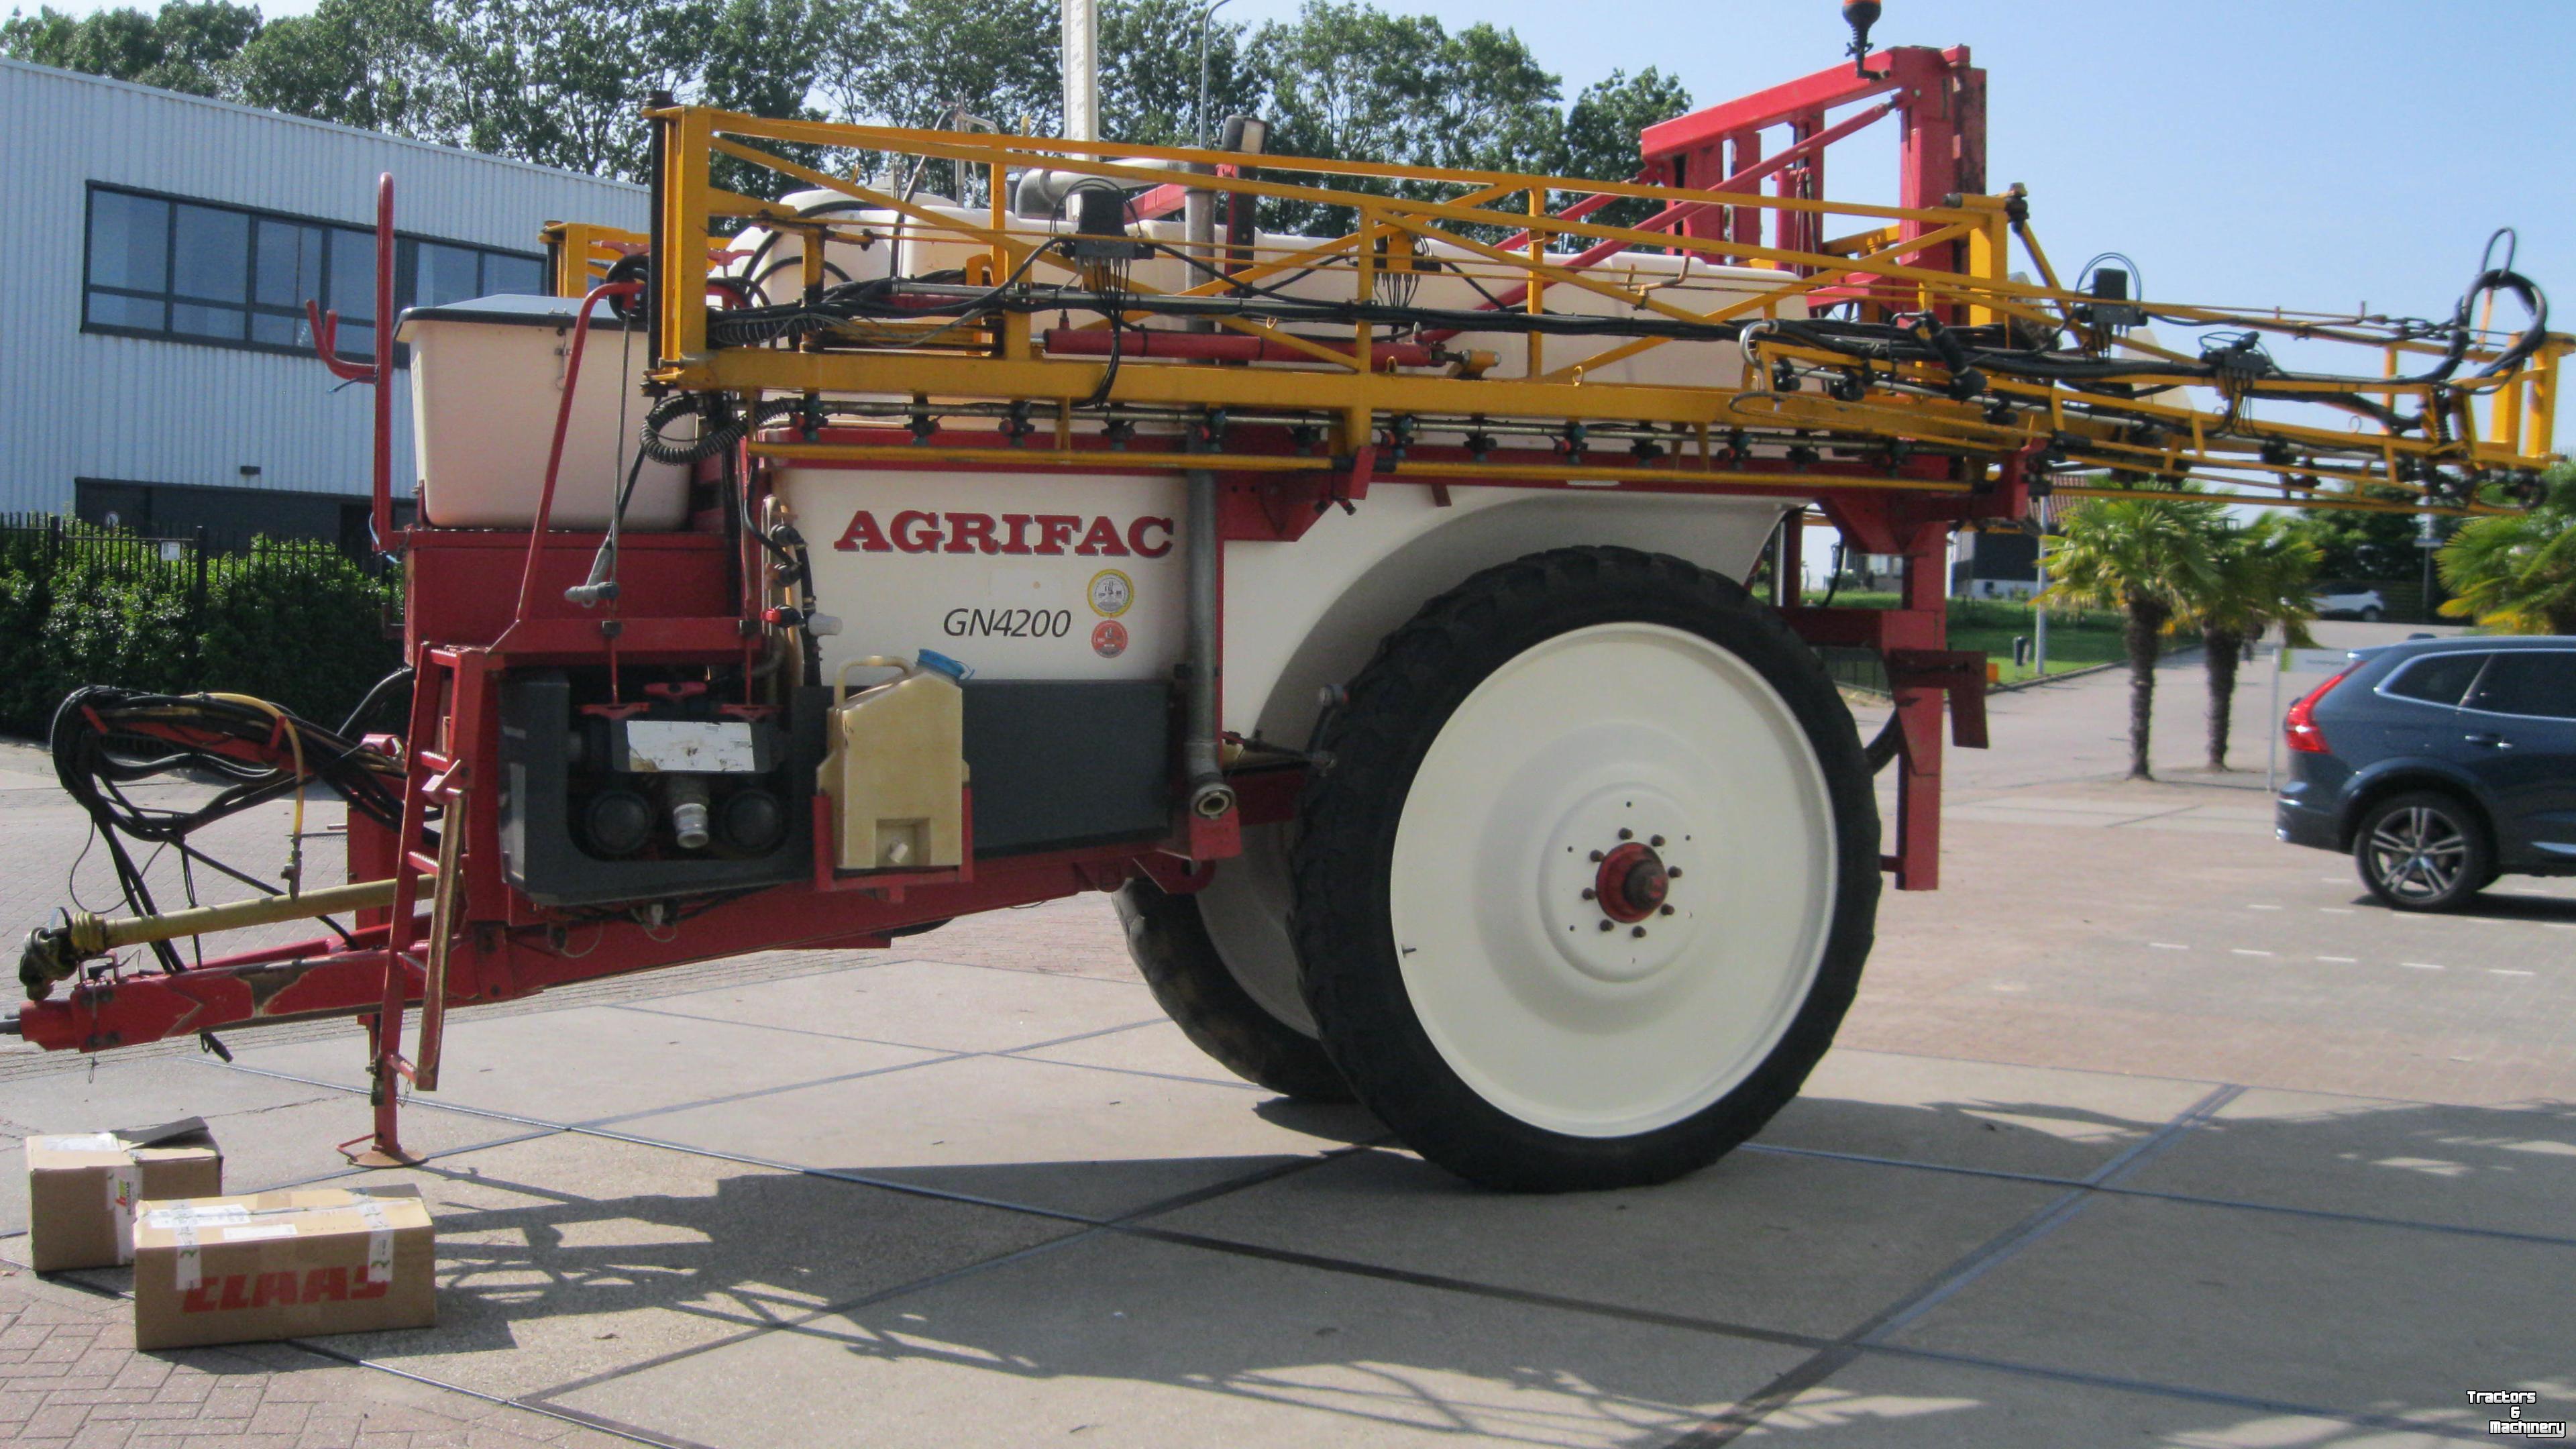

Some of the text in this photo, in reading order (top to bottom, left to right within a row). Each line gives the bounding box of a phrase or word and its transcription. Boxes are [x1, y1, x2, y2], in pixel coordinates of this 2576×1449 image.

[834, 510, 1173, 559] AGRIFAC
[943, 608, 1071, 637] GN4200
[182, 1265, 388, 1313] CLAAS
